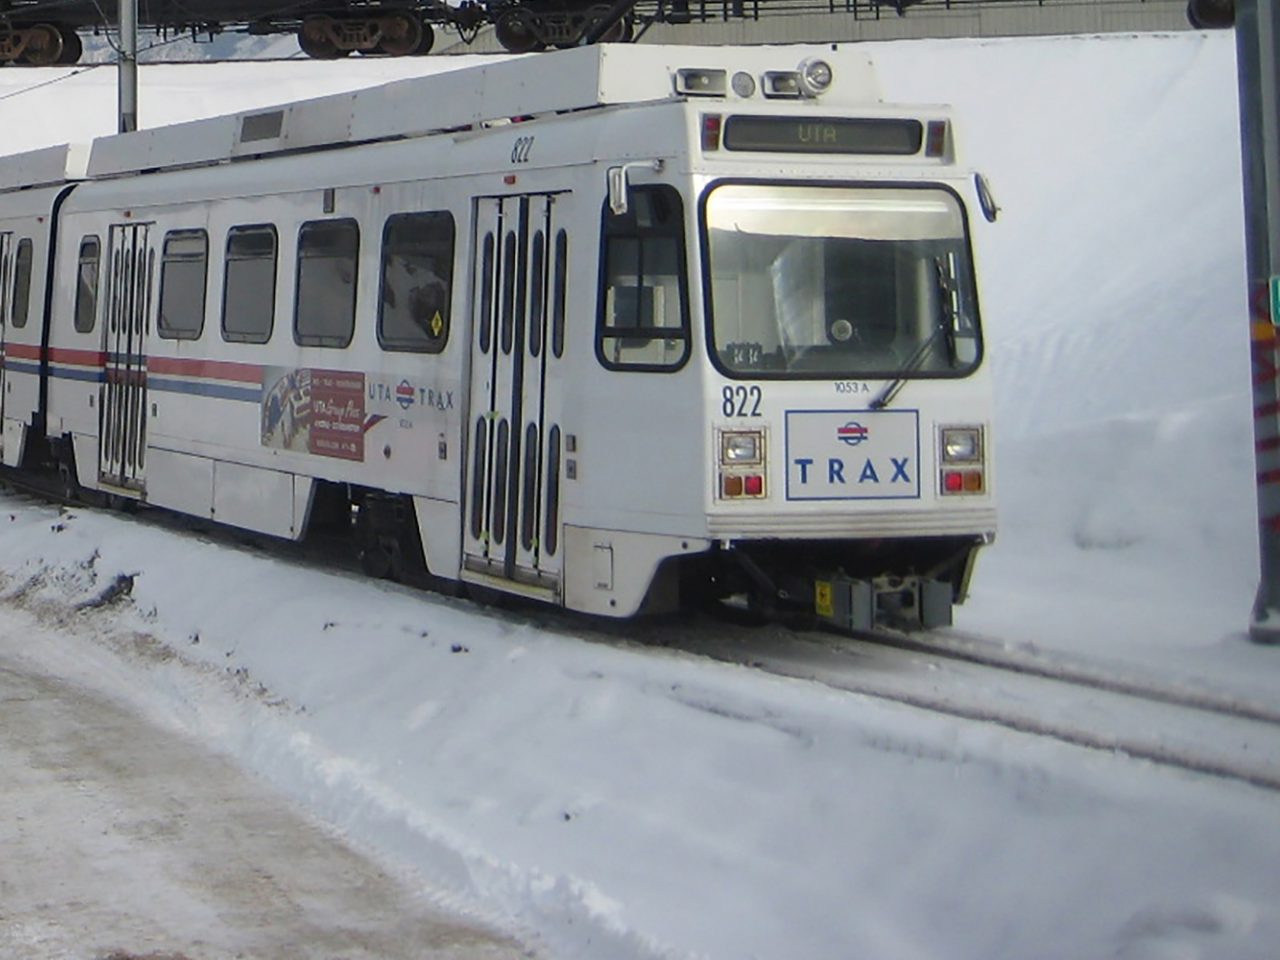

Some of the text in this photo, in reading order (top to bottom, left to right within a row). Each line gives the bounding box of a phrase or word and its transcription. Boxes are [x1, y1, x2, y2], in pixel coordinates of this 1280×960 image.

[511, 136, 535, 164] 822
[368, 383, 392, 402] UTA
[418, 387, 455, 411] TRAX
[722, 385, 763, 418] 822
[834, 381, 870, 394] 1053 A
[793, 457, 912, 485] TRAX
